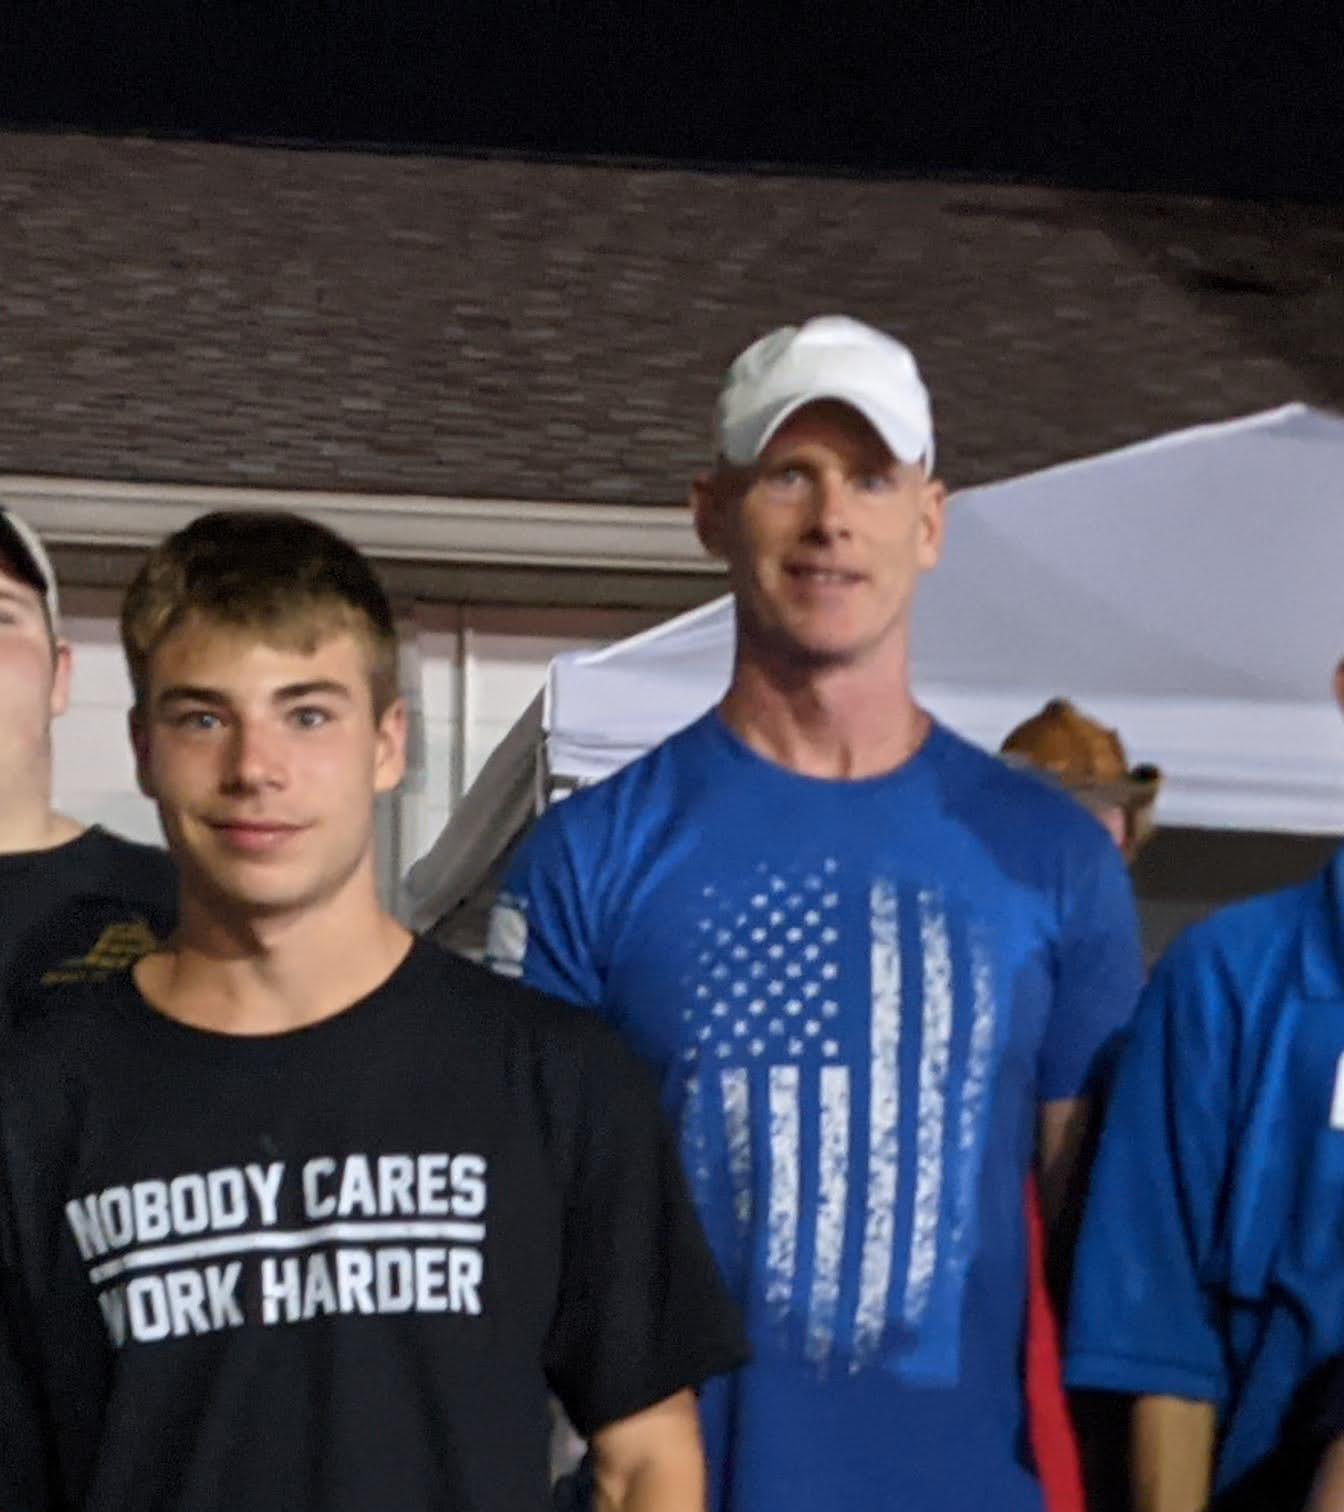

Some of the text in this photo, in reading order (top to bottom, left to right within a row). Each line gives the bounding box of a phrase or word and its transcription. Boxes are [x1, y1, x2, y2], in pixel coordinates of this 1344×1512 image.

[65, 1153, 487, 1261] NOBODY CARES
[262, 1247, 483, 1325] HARDER
